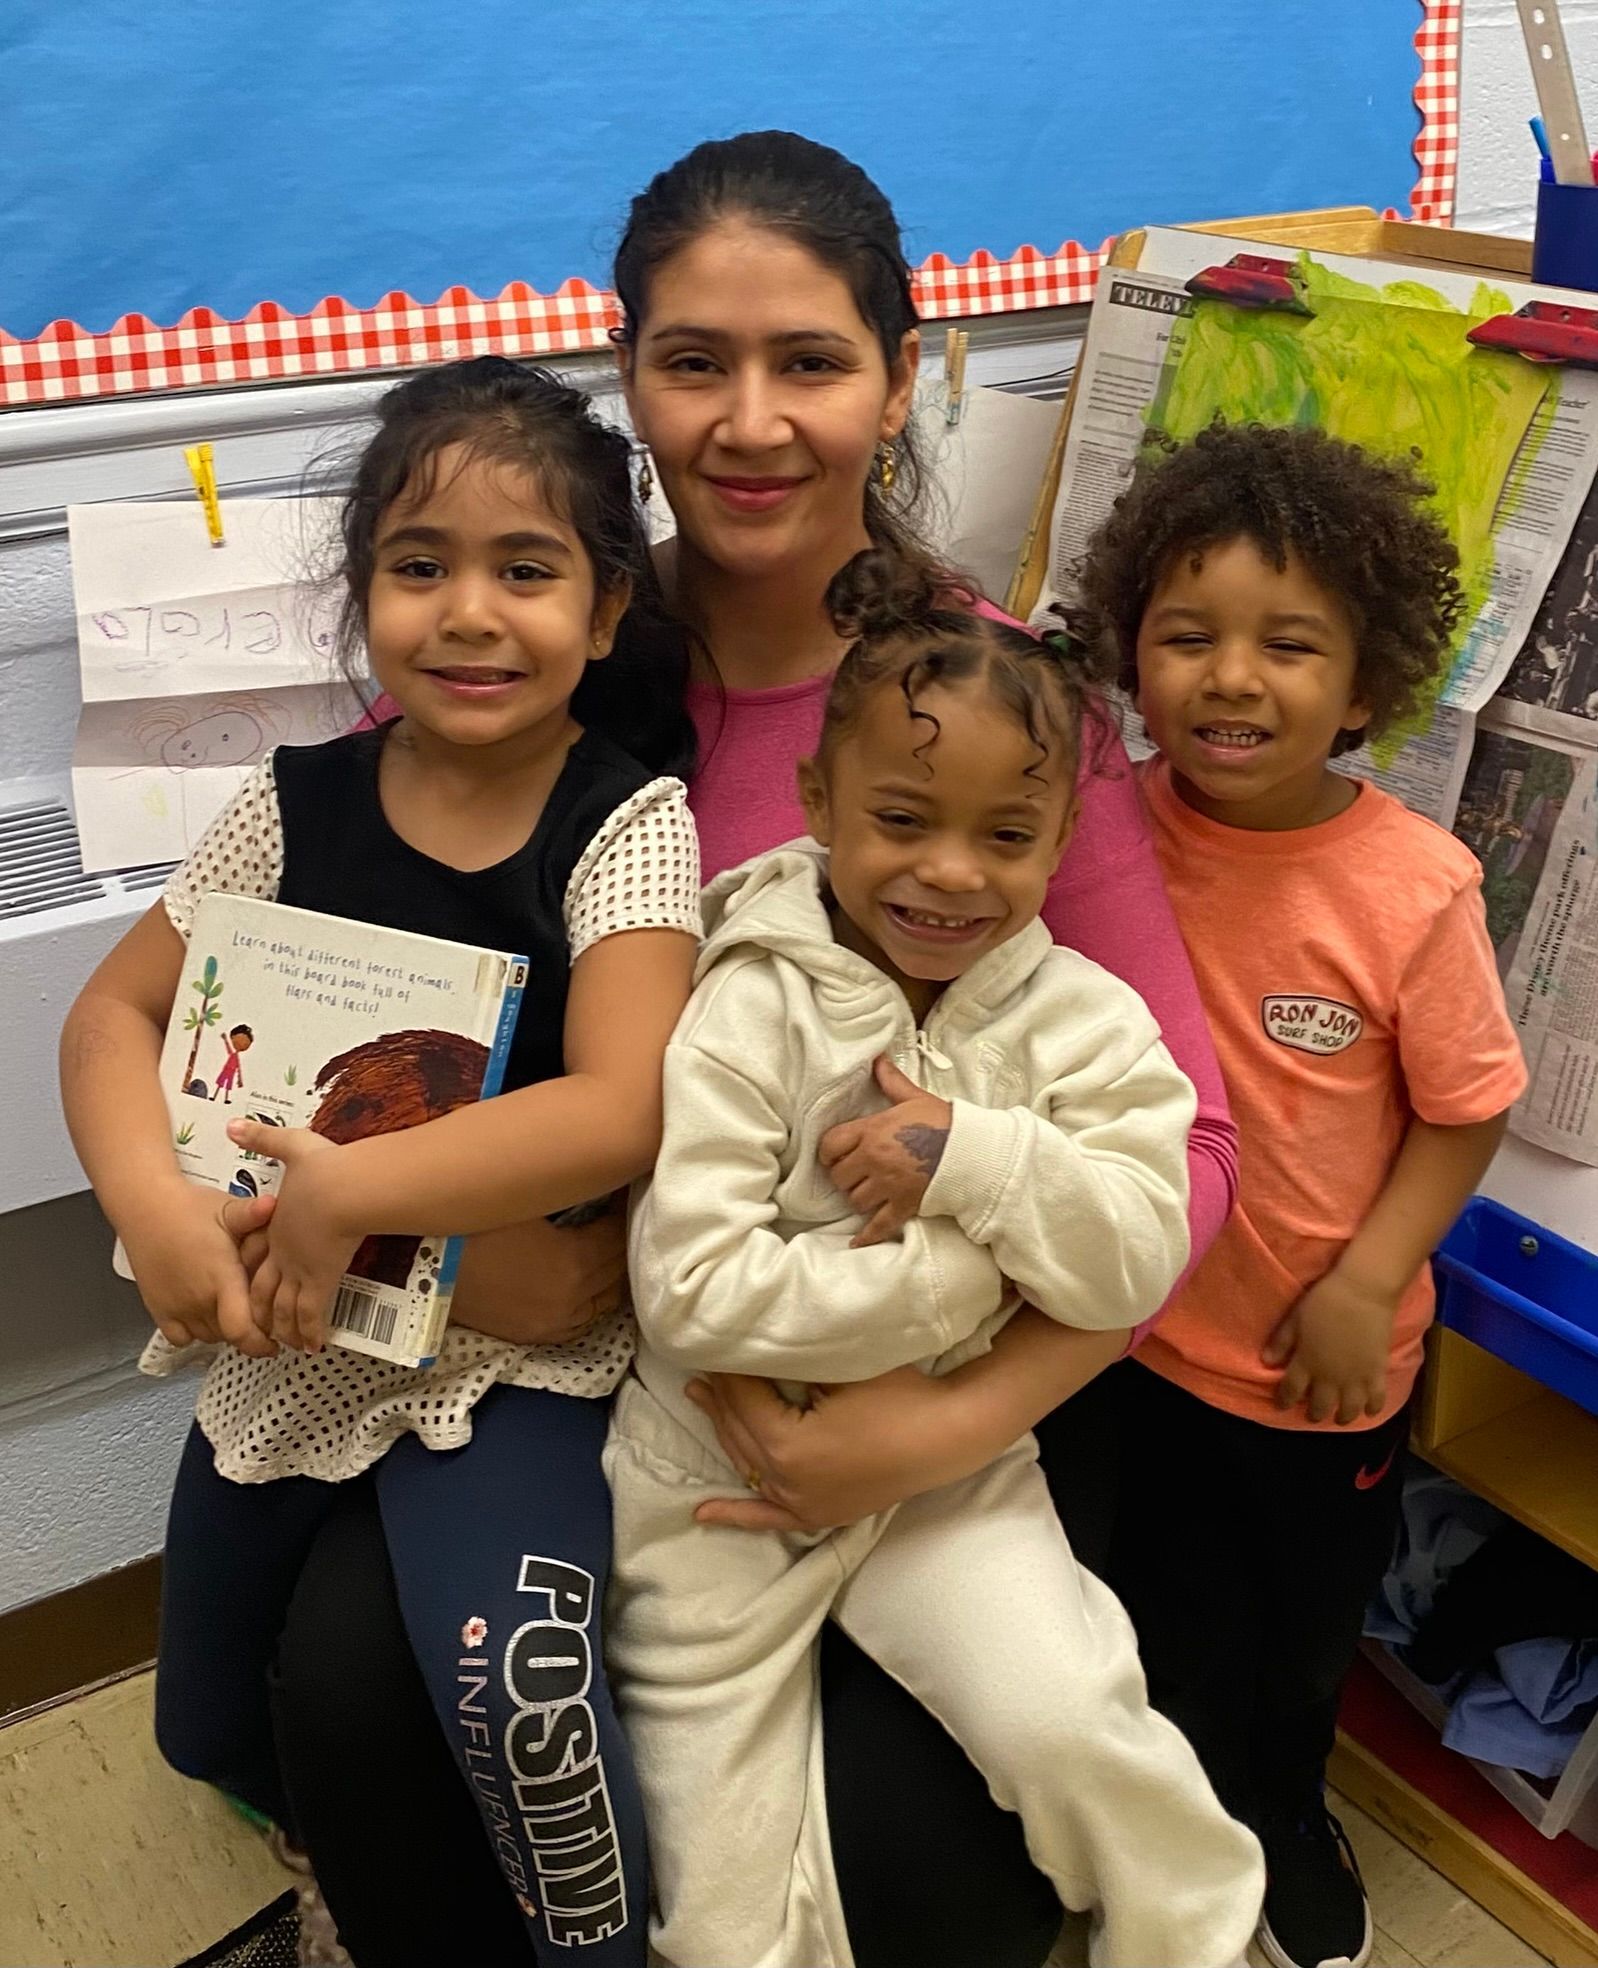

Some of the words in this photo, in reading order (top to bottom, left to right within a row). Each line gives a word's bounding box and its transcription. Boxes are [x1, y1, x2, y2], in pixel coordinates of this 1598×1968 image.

[232, 930, 266, 949] Learn
[270, 942, 303, 958] about
[307, 949, 360, 971] different
[367, 961, 403, 979] forest
[264, 959, 274, 970] in
[279, 962, 300, 977] this
[304, 967, 336, 986] board
[342, 976, 366, 992] book
[373, 984, 393, 998] full
[397, 990, 410, 1003] of
[514, 965, 524, 984] B
[286, 984, 312, 1000] flaps
[316, 993, 336, 1006] and
[343, 997, 379, 1018] facts!
[1269, 1004, 1318, 1023] RON
[1320, 1010, 1360, 1038] JON
[1277, 1024, 1307, 1039] SURF
[1312, 1032, 1344, 1048] SHOP
[503, 1554, 629, 1948] POSITIVE
[457, 1656, 529, 1894] INFLUENCER
